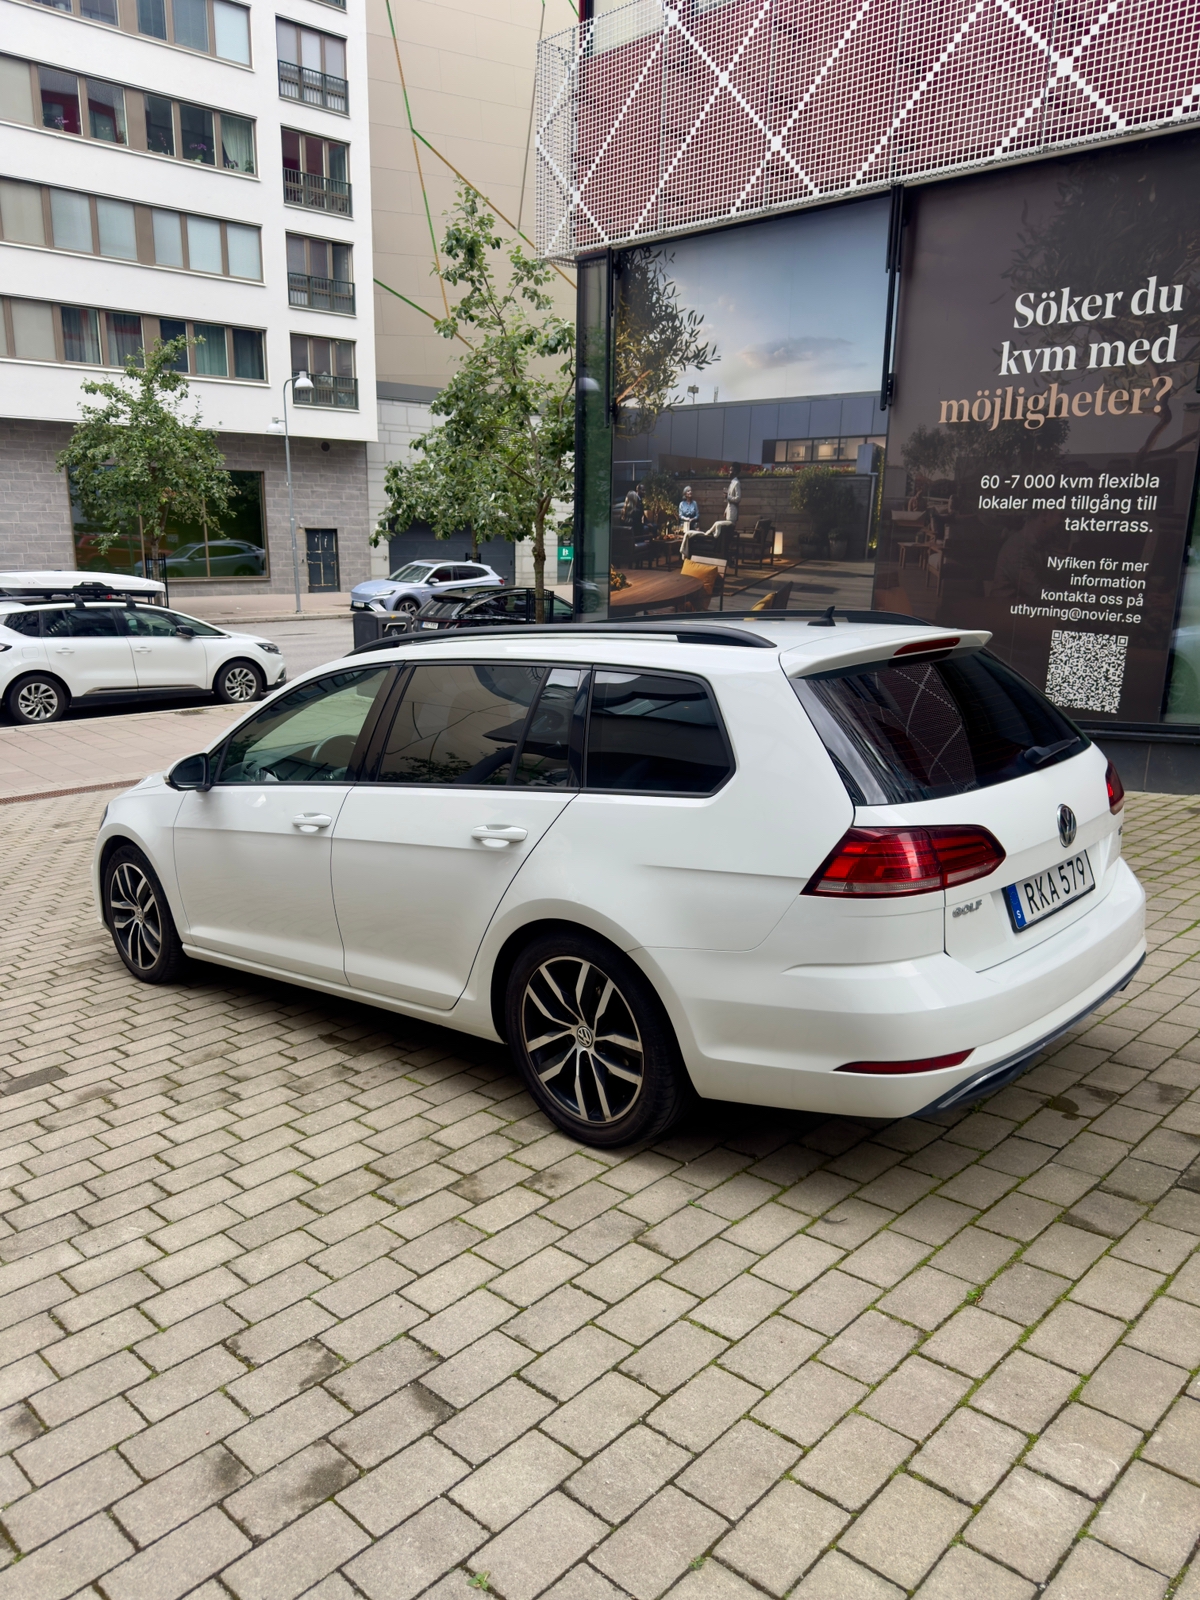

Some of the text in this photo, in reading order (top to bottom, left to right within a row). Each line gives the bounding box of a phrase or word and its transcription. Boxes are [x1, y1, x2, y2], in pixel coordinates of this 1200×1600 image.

[1013, 276, 1184, 329] Söker du
[998, 325, 1178, 376] kvm med
[939, 377, 1173, 431] möjligheter?
[980, 473, 1160, 489] 60 -7 000 kvm flexibla
[978, 494, 1157, 513] lokaler med tillgång till
[1064, 517, 1153, 532] takterrass.
[1047, 556, 1149, 572] Nyfiken för mer
[1070, 574, 1146, 589] information
[1040, 589, 1144, 608] kontakta oss på
[1010, 605, 1142, 623] uthyrning@novier.se
[1024, 857, 1085, 914] RKA 579
[952, 899, 982, 918] GOLF
[1016, 910, 1022, 919] S
